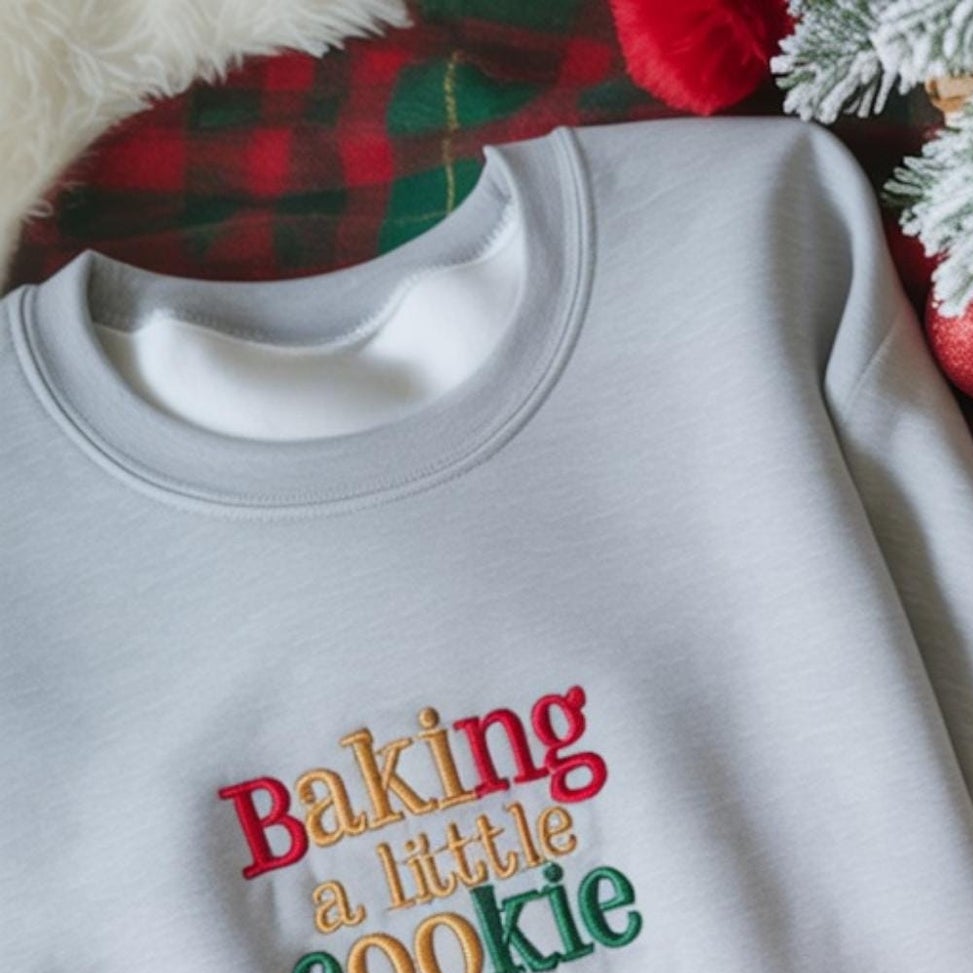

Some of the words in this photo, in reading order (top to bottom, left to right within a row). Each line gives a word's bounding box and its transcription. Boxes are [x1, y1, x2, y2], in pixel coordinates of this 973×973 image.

[217, 685, 608, 880] Baking
[313, 880, 366, 934] a
[386, 802, 577, 911] little
